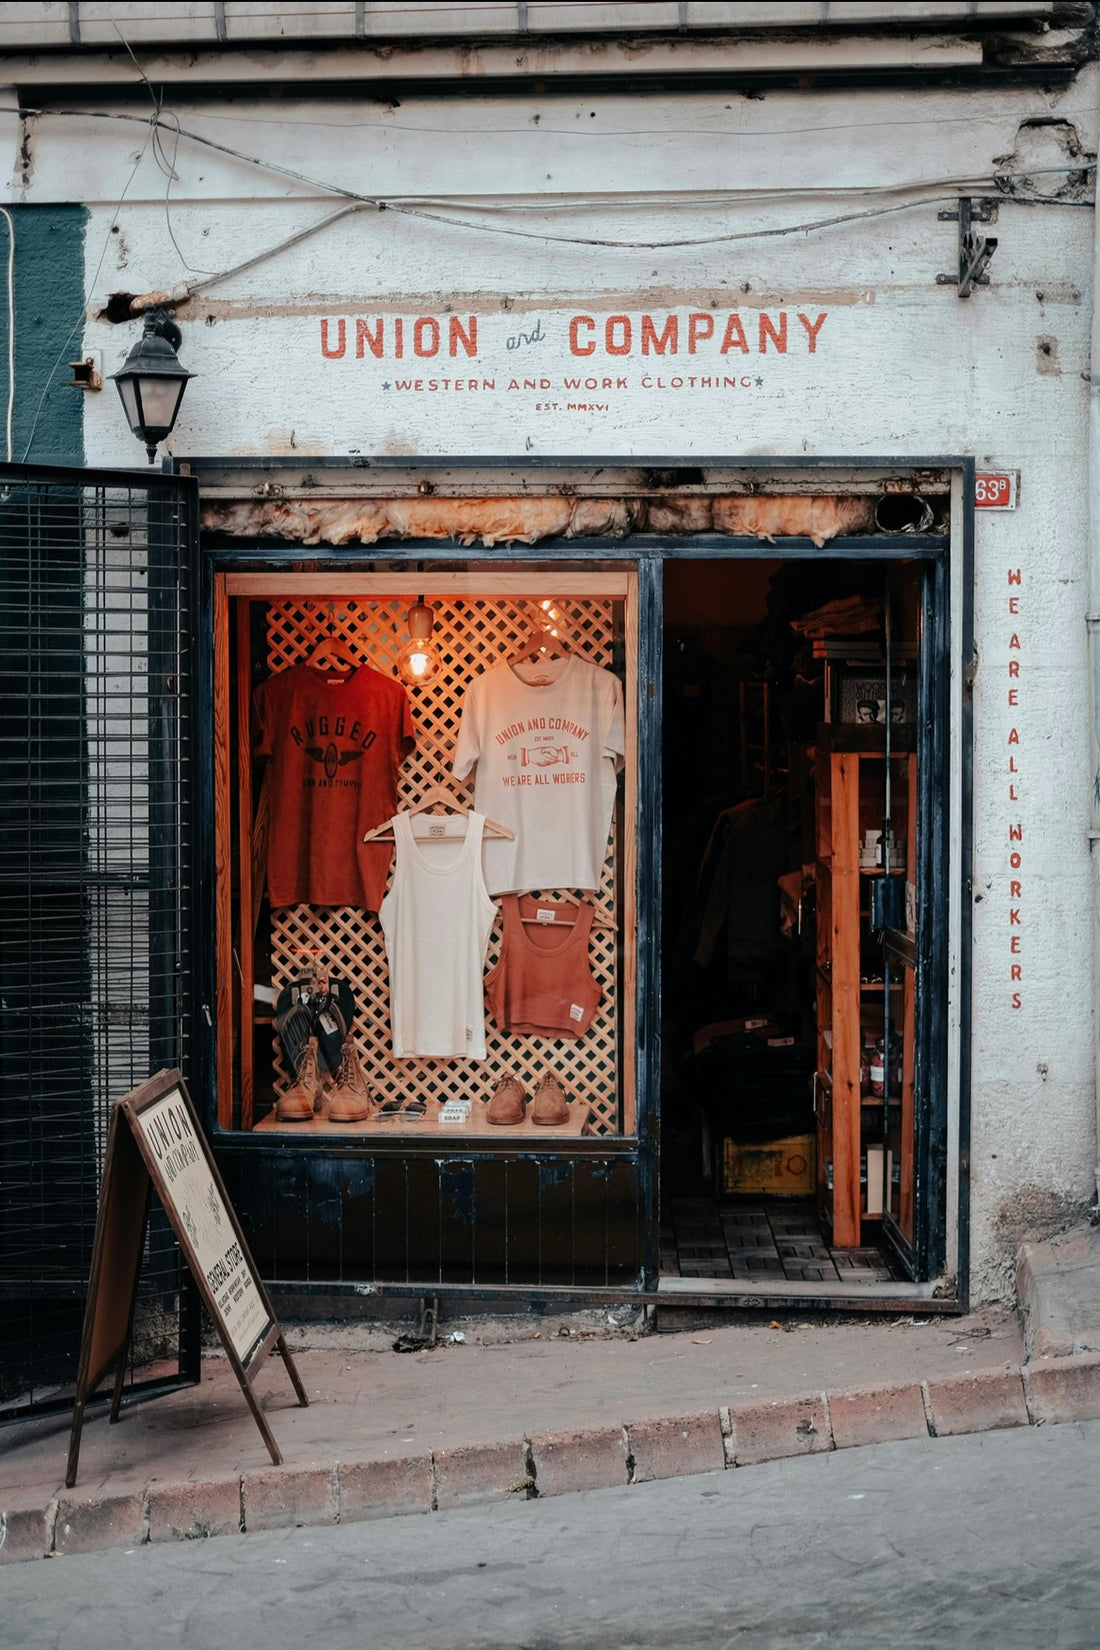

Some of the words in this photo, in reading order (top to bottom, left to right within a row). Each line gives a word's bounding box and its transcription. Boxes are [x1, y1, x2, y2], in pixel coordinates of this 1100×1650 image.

[320, 315, 478, 359] UNION
[506, 319, 546, 350] and
[569, 312, 828, 357] COMPANY
[395, 379, 496, 391] WESTERN
[508, 378, 551, 390] AND
[564, 377, 628, 390] WORK
[641, 376, 751, 389] CLOTHING
[535, 402, 562, 411] EST.
[567, 402, 609, 412] MMXVI
[1008, 568, 1022, 614] WE
[1008, 633, 1021, 706] ARE
[290, 716, 377, 750] RUGGED
[495, 721, 526, 745] UNION
[527, 717, 546, 731] AND
[548, 717, 590, 741] COMPANY
[503, 776, 516, 787] WE
[517, 775, 532, 786] ARE
[534, 774, 550, 785] ALL
[1008, 728, 1019, 801] ALL
[1009, 824, 1022, 1010] WORKERS
[146, 1104, 193, 1160] UNION
[224, 1241, 244, 1273] STORE
